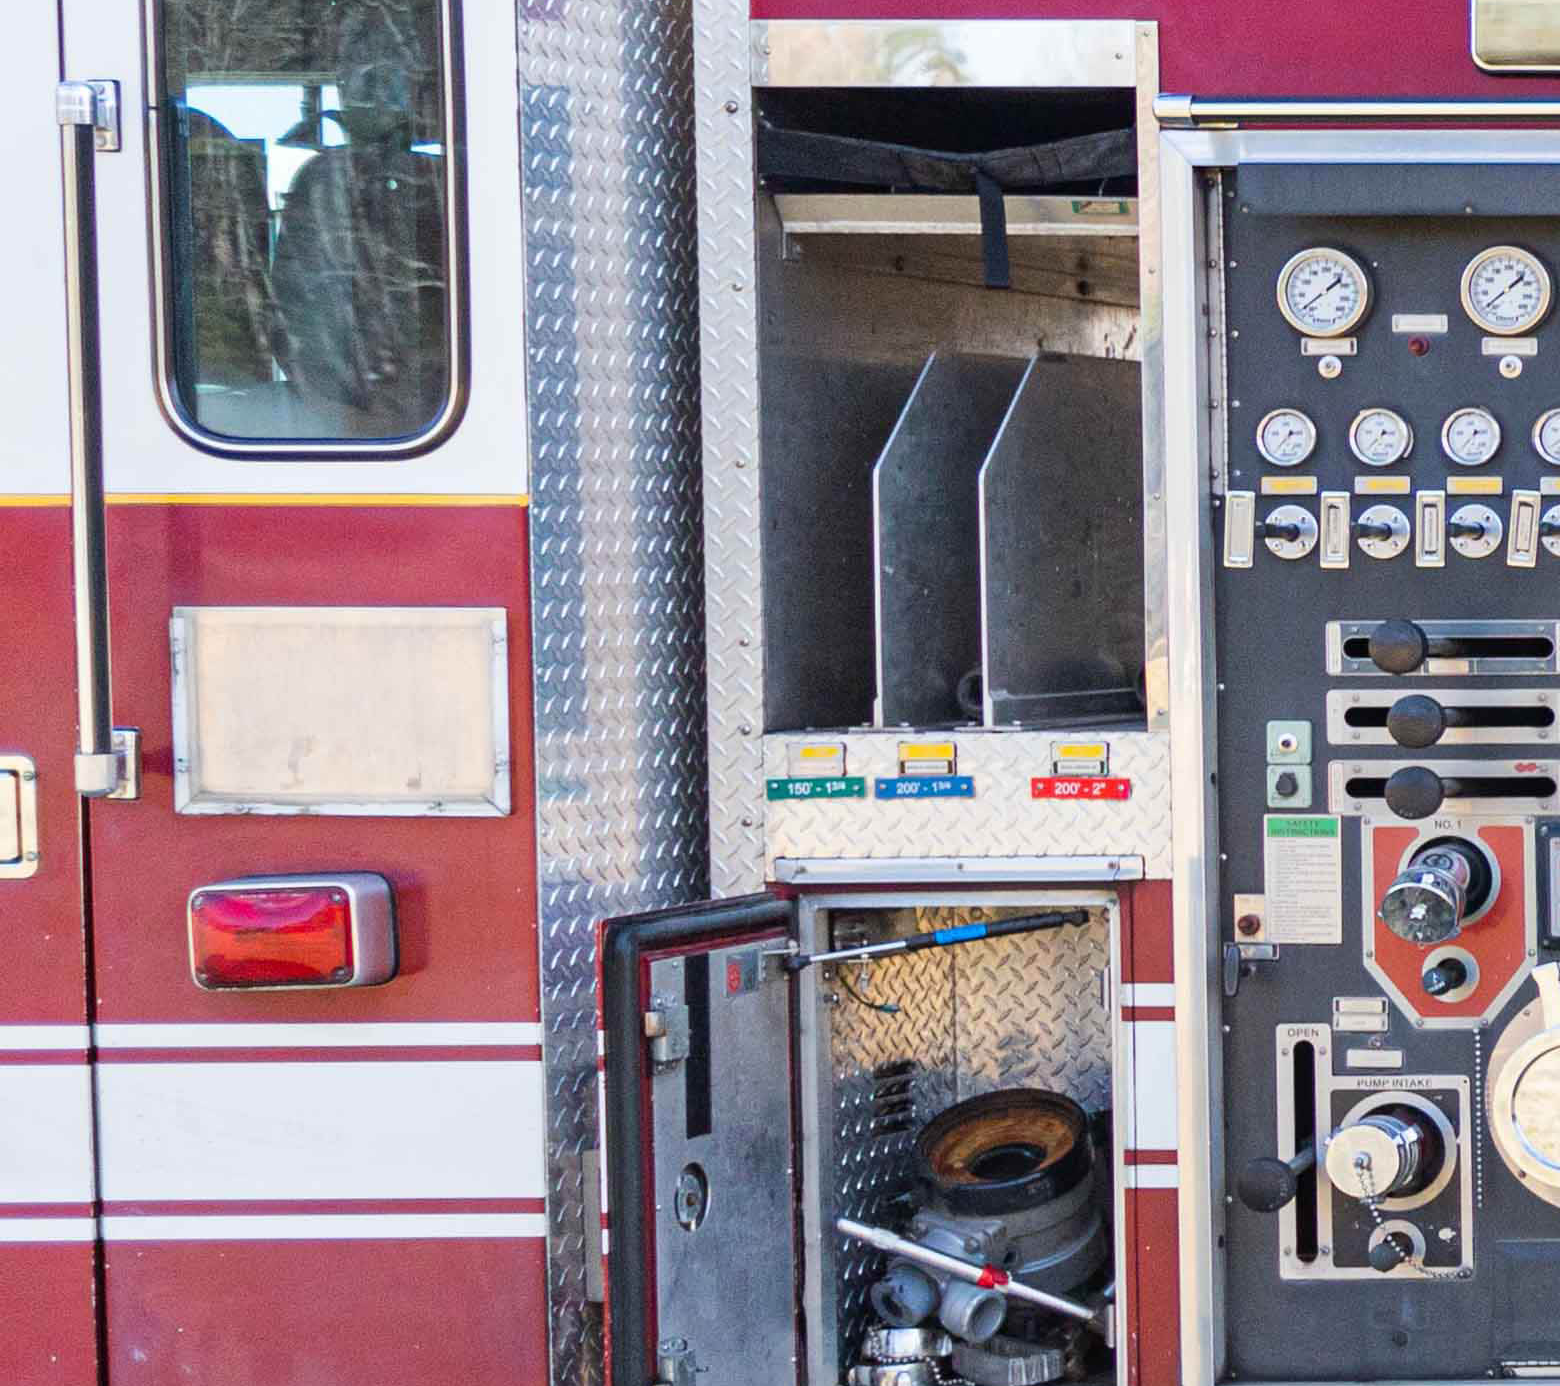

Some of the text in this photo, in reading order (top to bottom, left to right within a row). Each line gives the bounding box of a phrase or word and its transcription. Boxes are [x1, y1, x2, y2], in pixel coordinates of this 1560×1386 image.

[1287, 1028, 1320, 1038] OPEN
[1356, 1078, 1433, 1088] PUMP INTAKE
